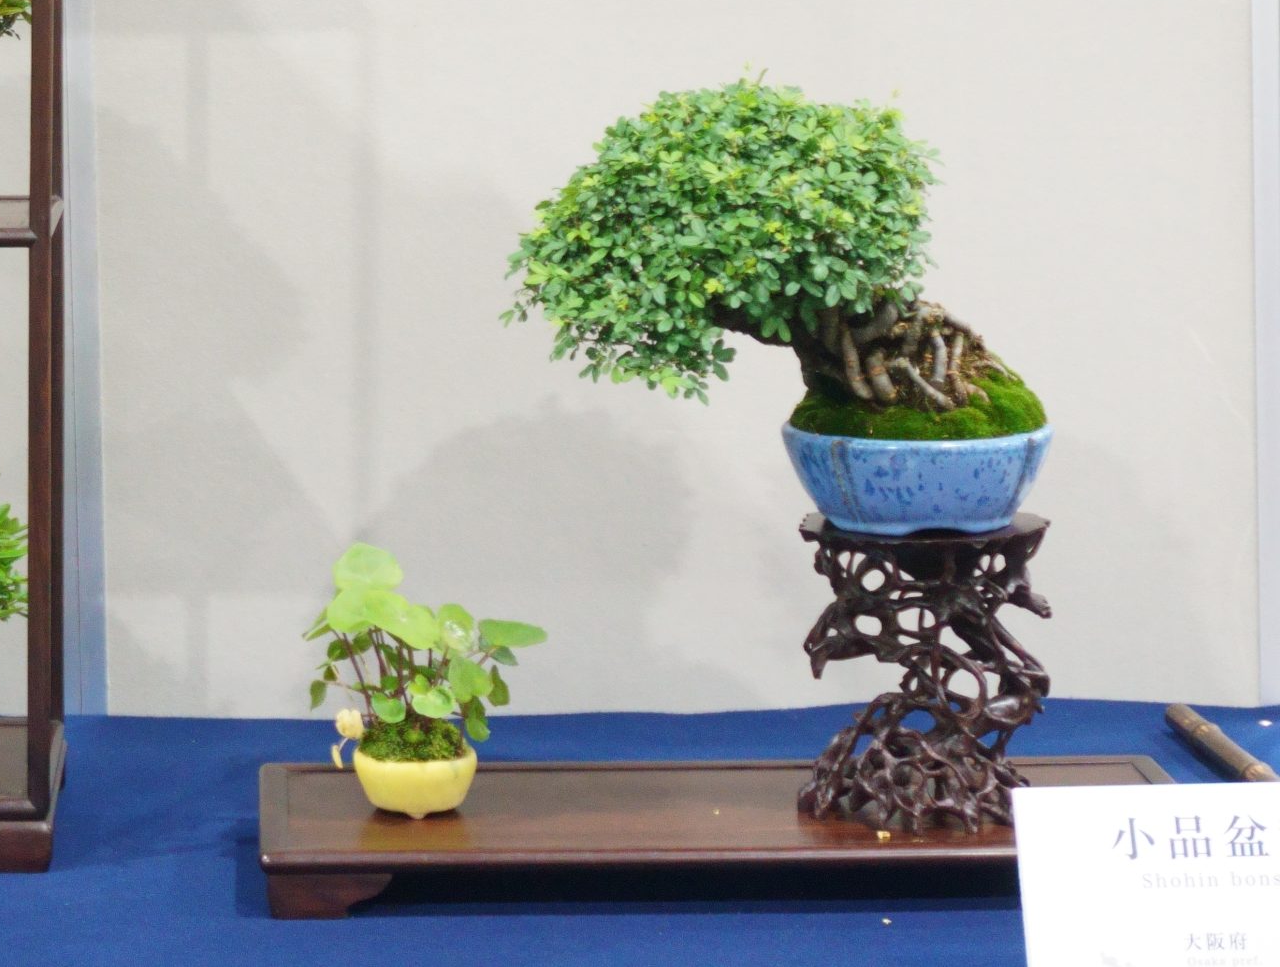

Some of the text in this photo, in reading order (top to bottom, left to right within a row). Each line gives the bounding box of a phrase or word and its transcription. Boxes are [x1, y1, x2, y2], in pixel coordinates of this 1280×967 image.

[1112, 814, 1271, 861] 小品盆
[1142, 872, 1219, 889] Shohin
[1185, 932, 1247, 951] 大阪府
